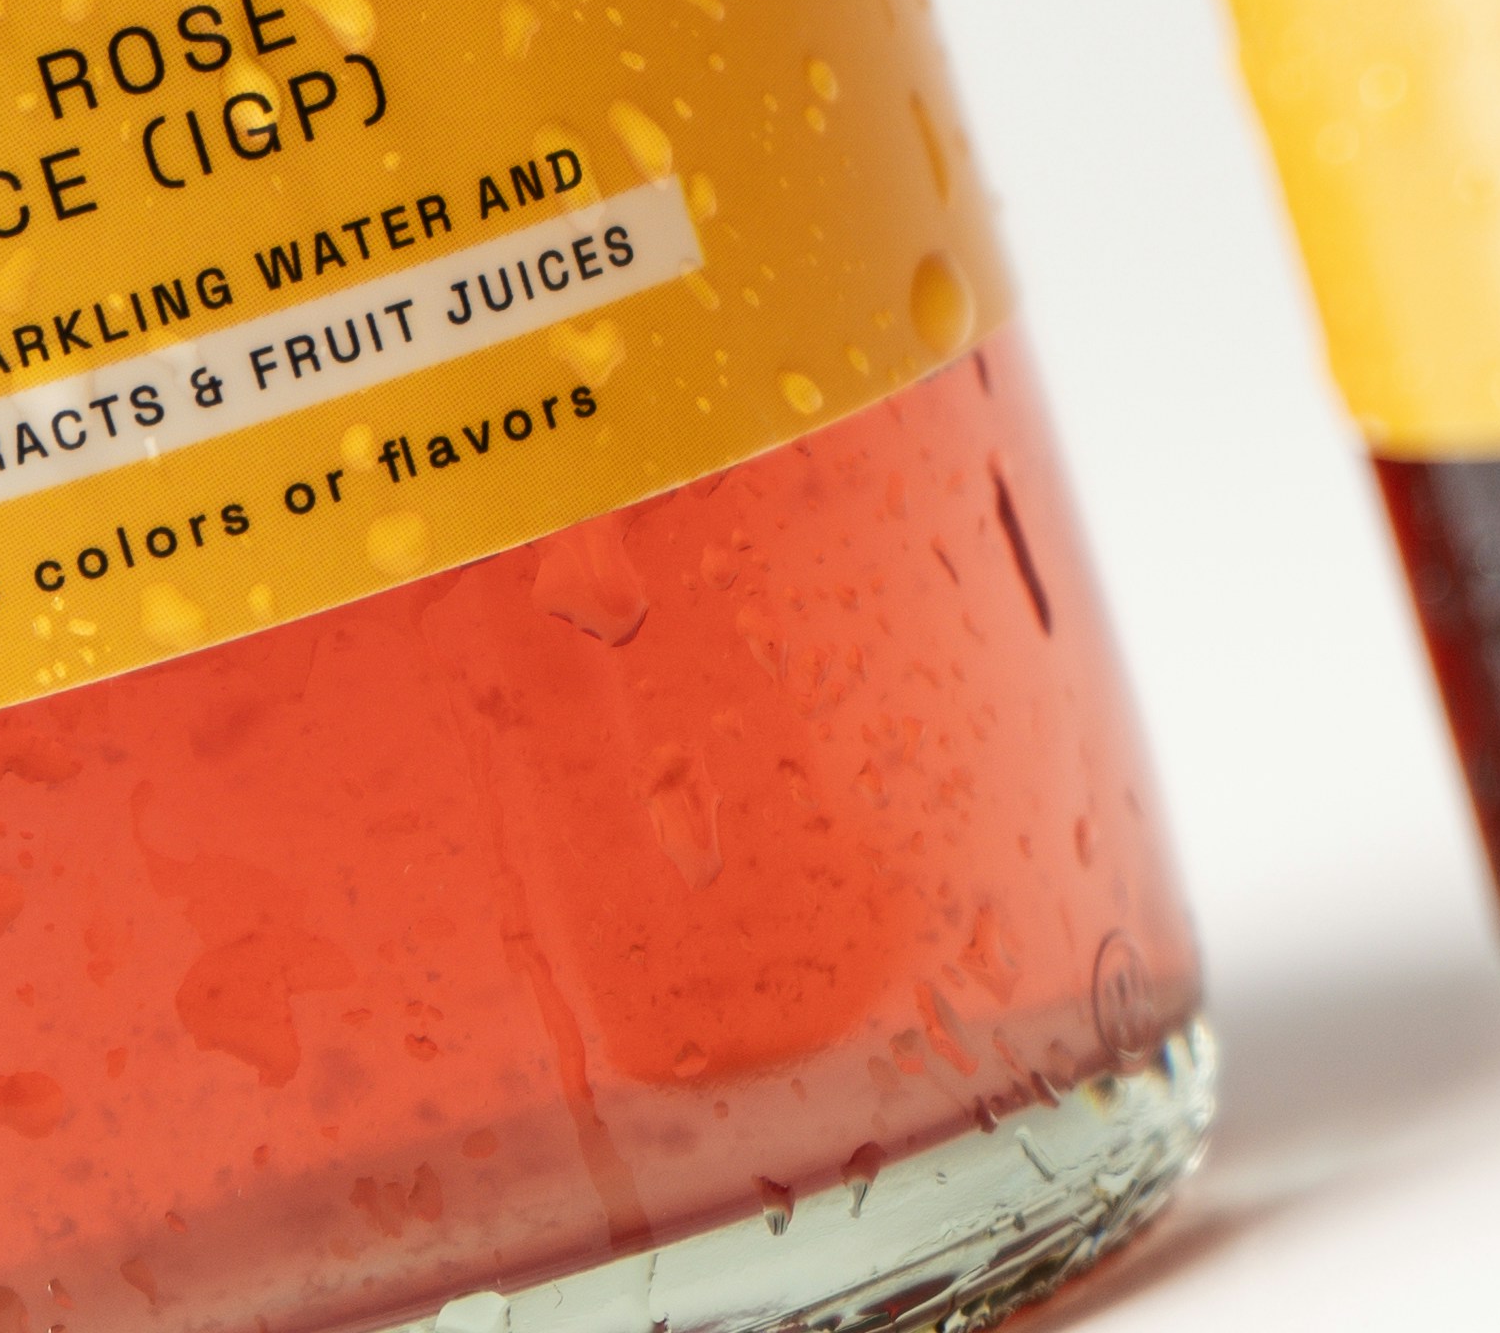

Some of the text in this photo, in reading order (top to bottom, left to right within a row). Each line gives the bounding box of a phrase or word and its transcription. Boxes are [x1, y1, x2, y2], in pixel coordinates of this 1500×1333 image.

[141, 53, 389, 190] (IGP)
[253, 193, 454, 292] WATER
[476, 148, 585, 221] AND
[189, 366, 224, 409] &
[247, 299, 415, 391] FRUIT
[446, 225, 636, 326] JUICES
[33, 502, 252, 593] colors
[283, 467, 345, 515] or
[377, 384, 599, 484] flavors
